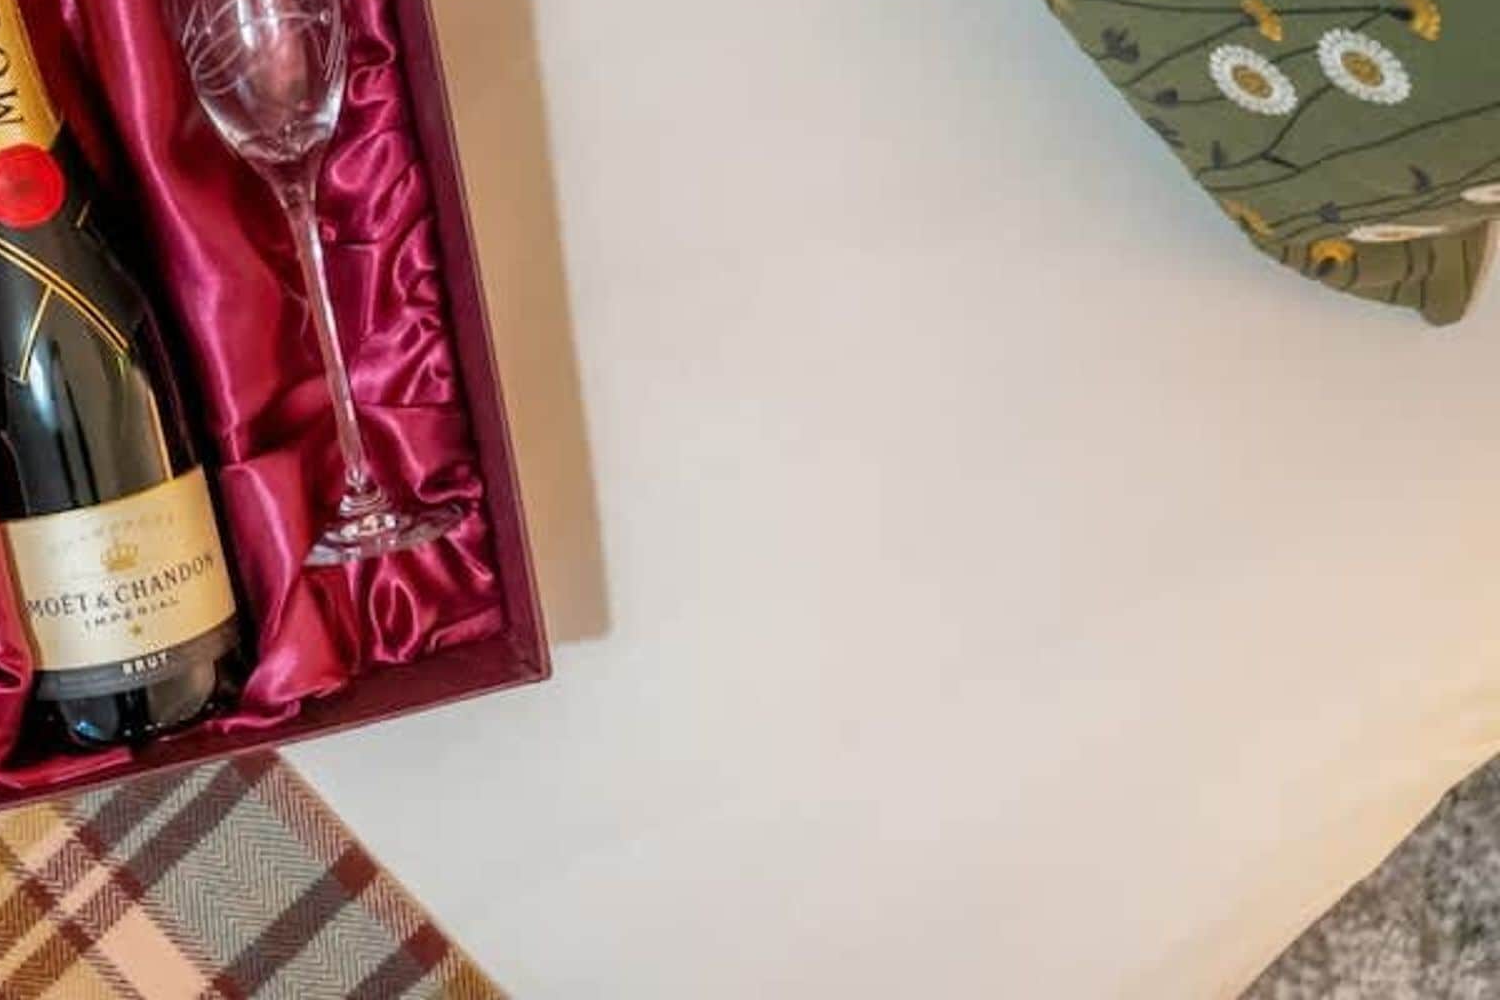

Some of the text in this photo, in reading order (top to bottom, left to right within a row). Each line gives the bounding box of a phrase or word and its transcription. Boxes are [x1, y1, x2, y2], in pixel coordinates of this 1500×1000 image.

[97, 591, 109, 609] &
[114, 553, 214, 604] CHANDON
[122, 651, 167, 677] BRUT
